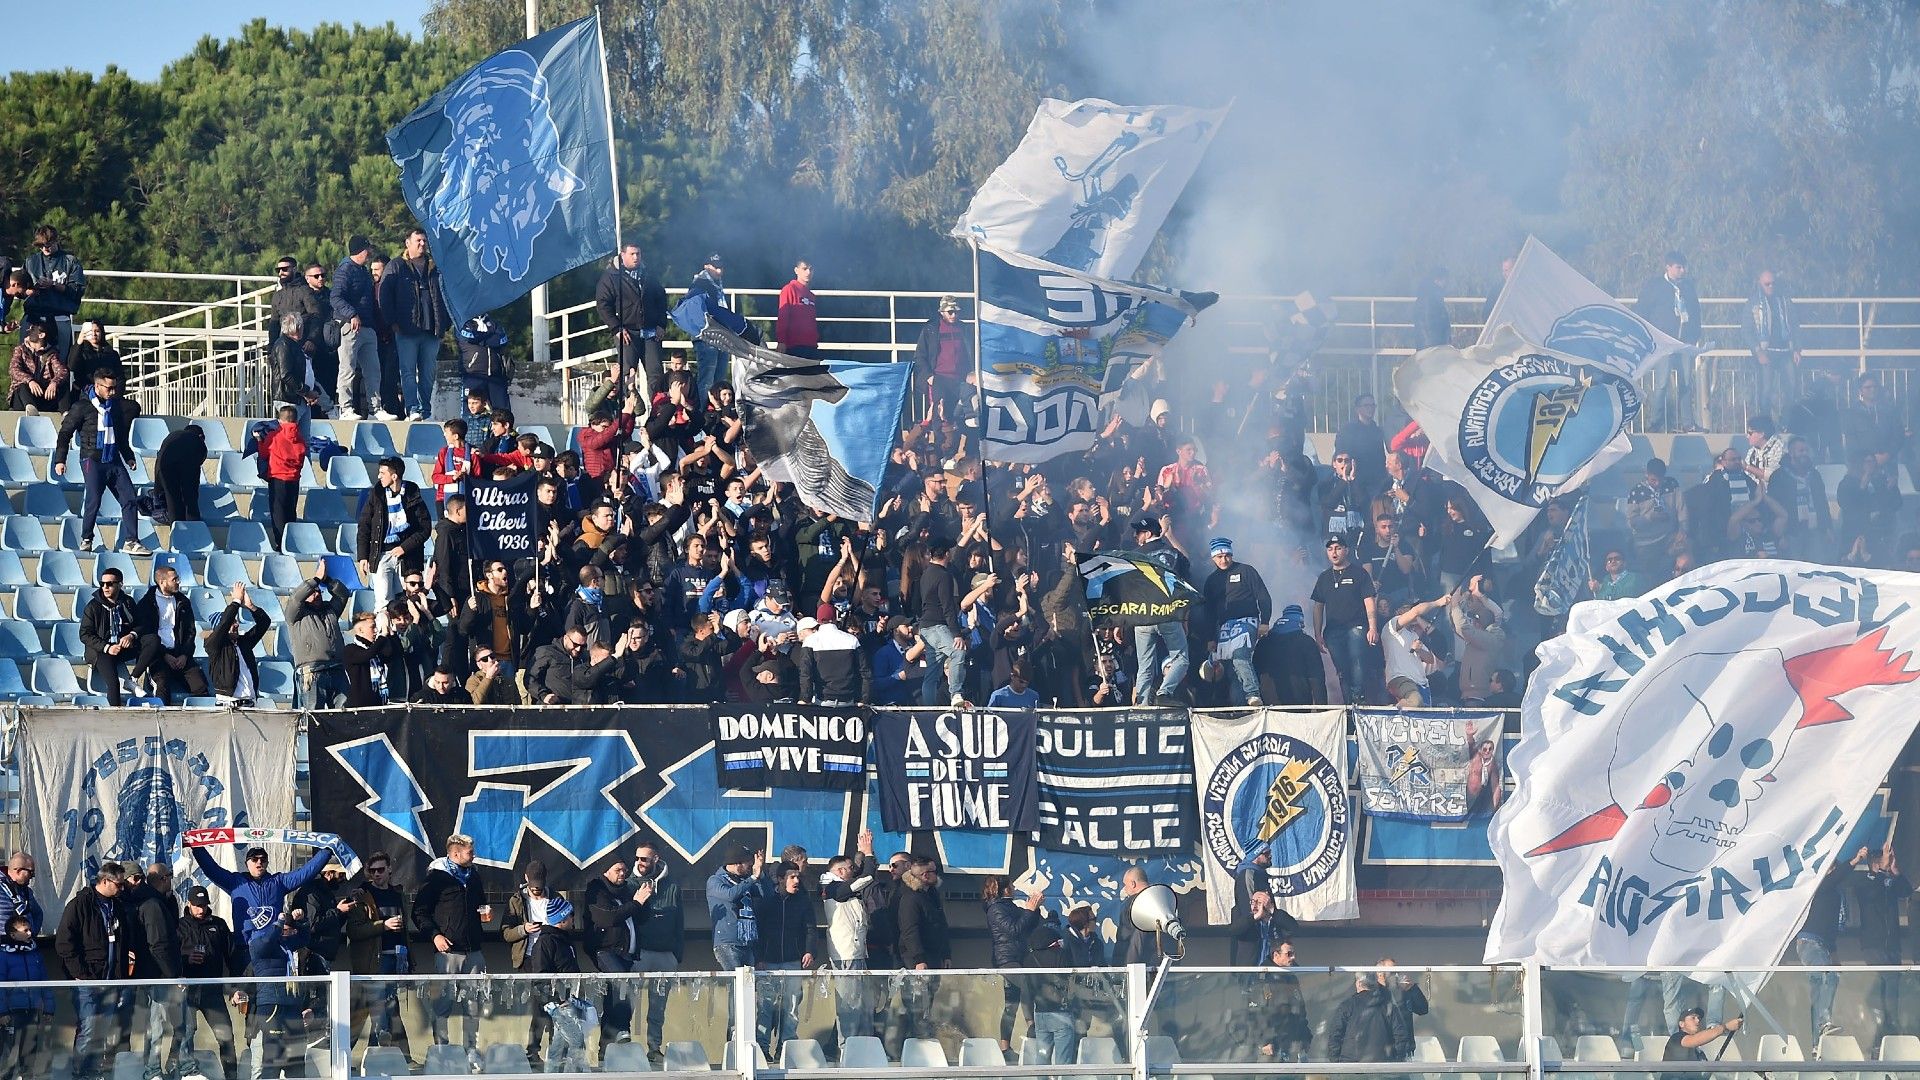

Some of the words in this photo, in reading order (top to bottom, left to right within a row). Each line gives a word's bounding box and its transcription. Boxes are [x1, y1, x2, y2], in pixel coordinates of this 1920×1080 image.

[472, 487, 529, 507] Ultras
[477, 511, 527, 531] Liberi
[498, 534, 530, 550] 1936
[1086, 602, 1147, 619] ESCARA
[718, 713, 864, 743] DOMENICO
[904, 714, 931, 759] A
[935, 713, 1009, 759] SUD
[1361, 714, 1466, 746] MICHEL
[761, 746, 821, 773] VIVE
[932, 758, 979, 782] DEL
[1208, 754, 1244, 802] VECCHIA
[907, 782, 1010, 828] FIUME
[1365, 787, 1467, 815] SEMPRE
